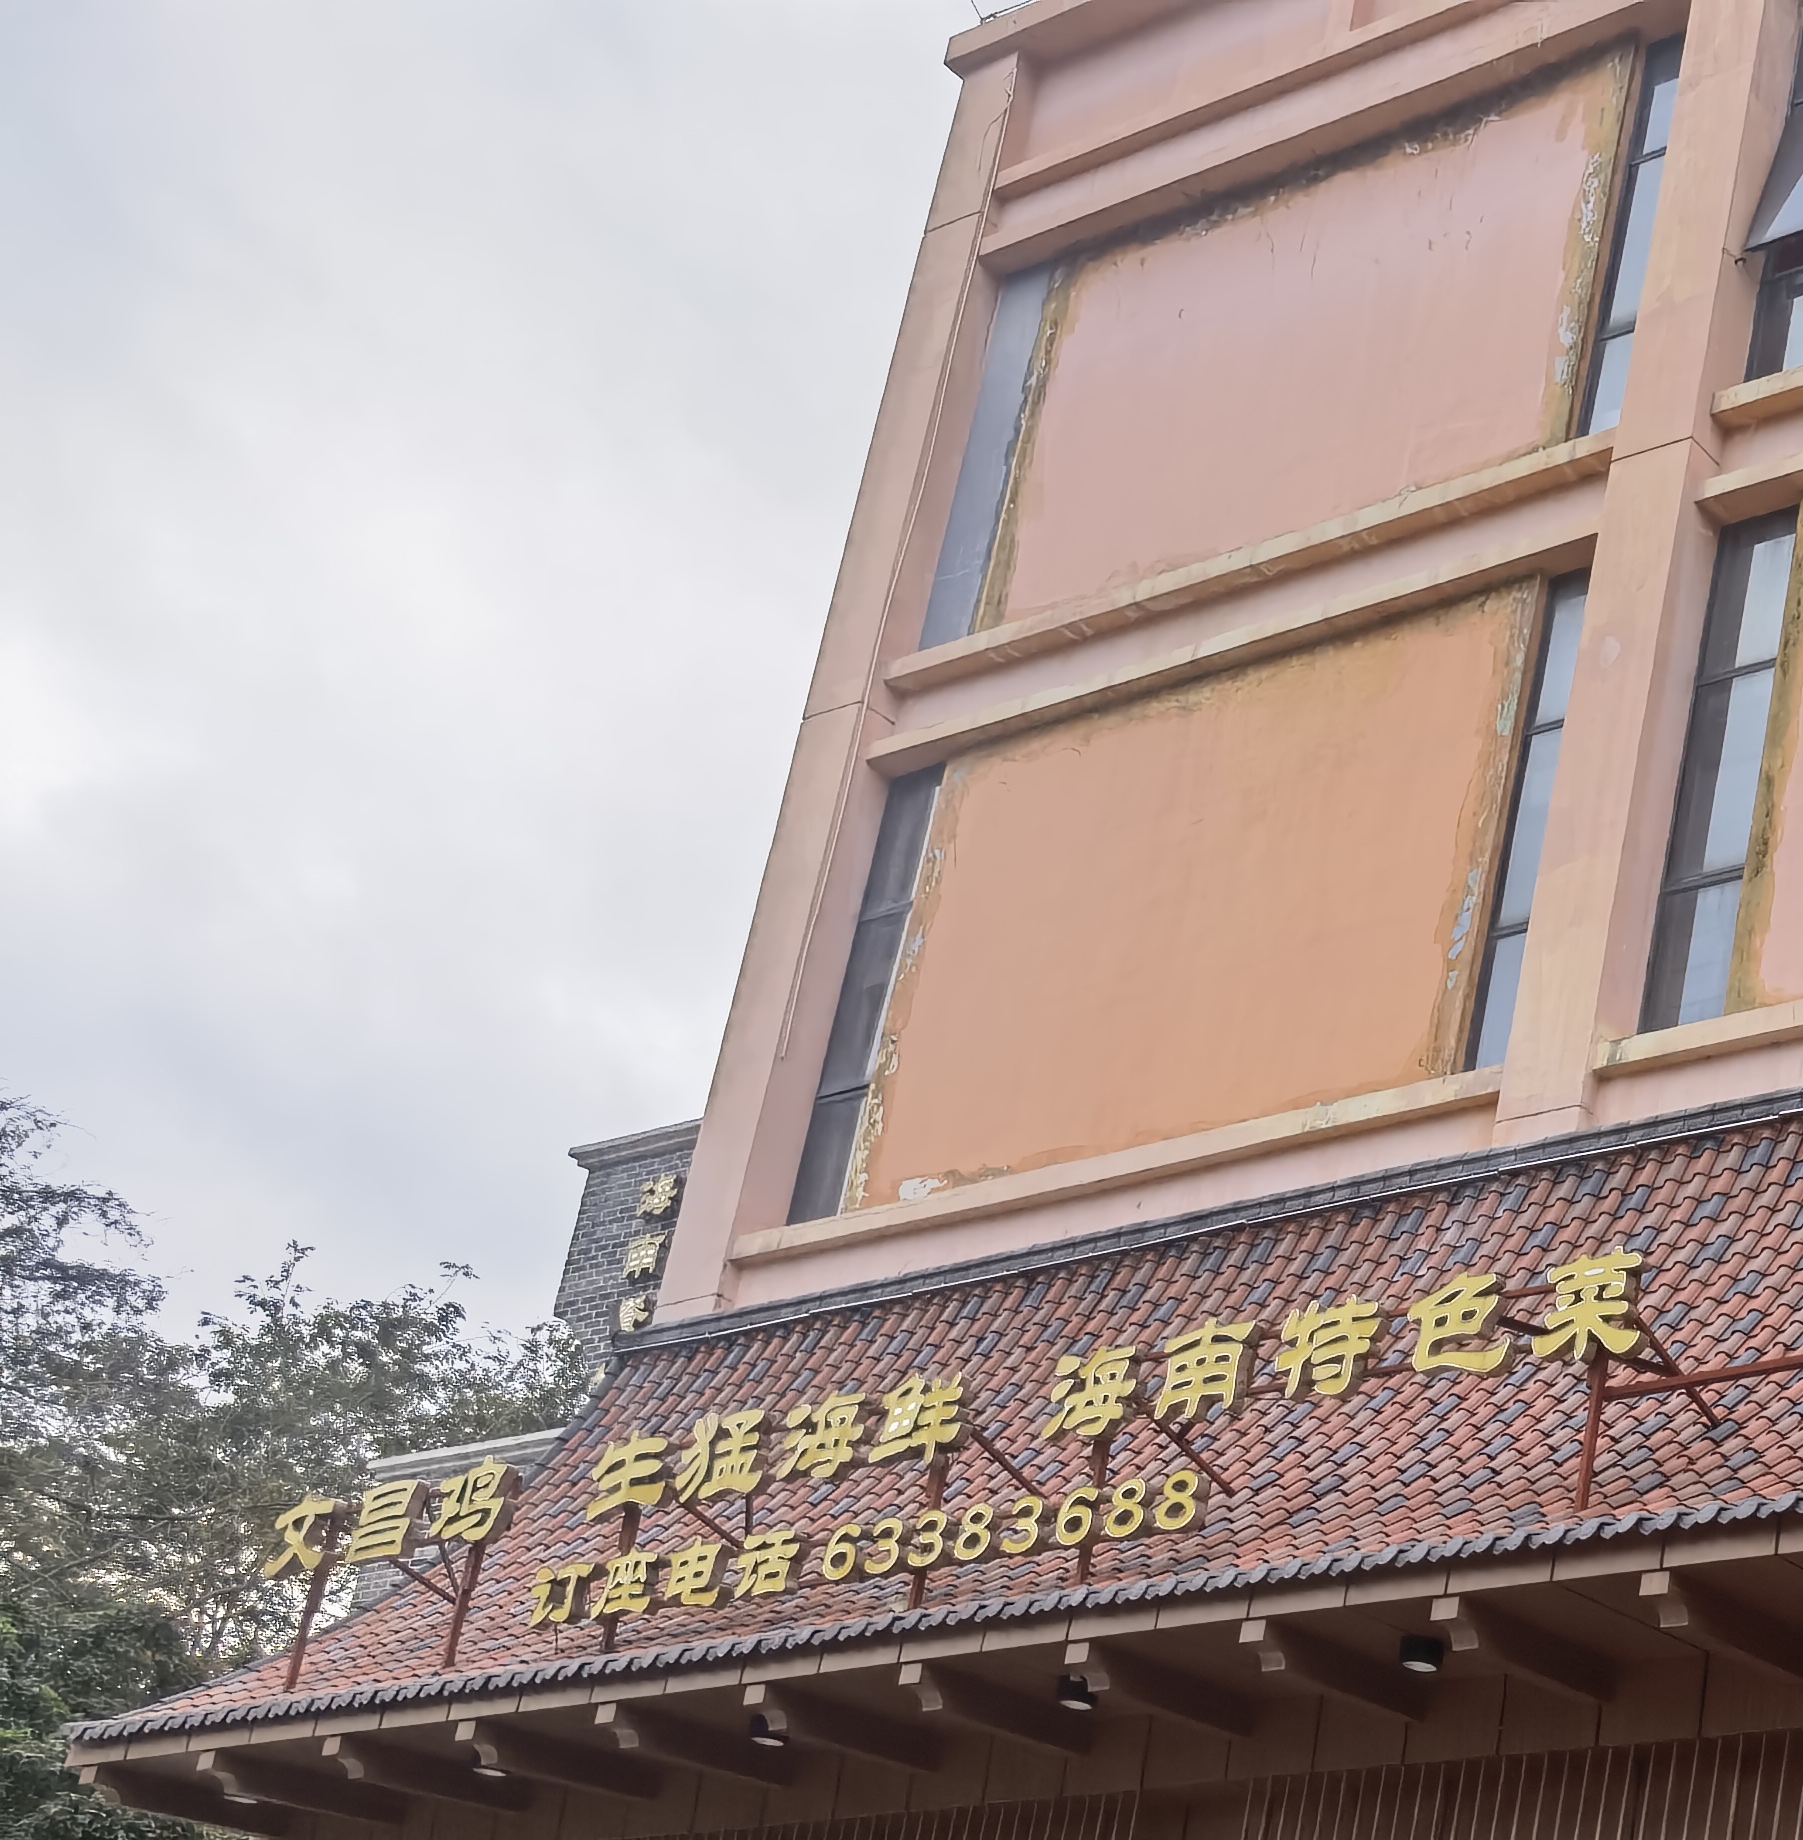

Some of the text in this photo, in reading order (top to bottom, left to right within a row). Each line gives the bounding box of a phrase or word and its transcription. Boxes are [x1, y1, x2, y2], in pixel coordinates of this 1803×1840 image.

[1040, 1248, 1645, 1440] 海南特色菜
[264, 1456, 511, 1579] 文昌鸡
[585, 1371, 965, 1522] 生猛海鲜
[529, 1471, 1201, 1628] 订座电话 63383688
